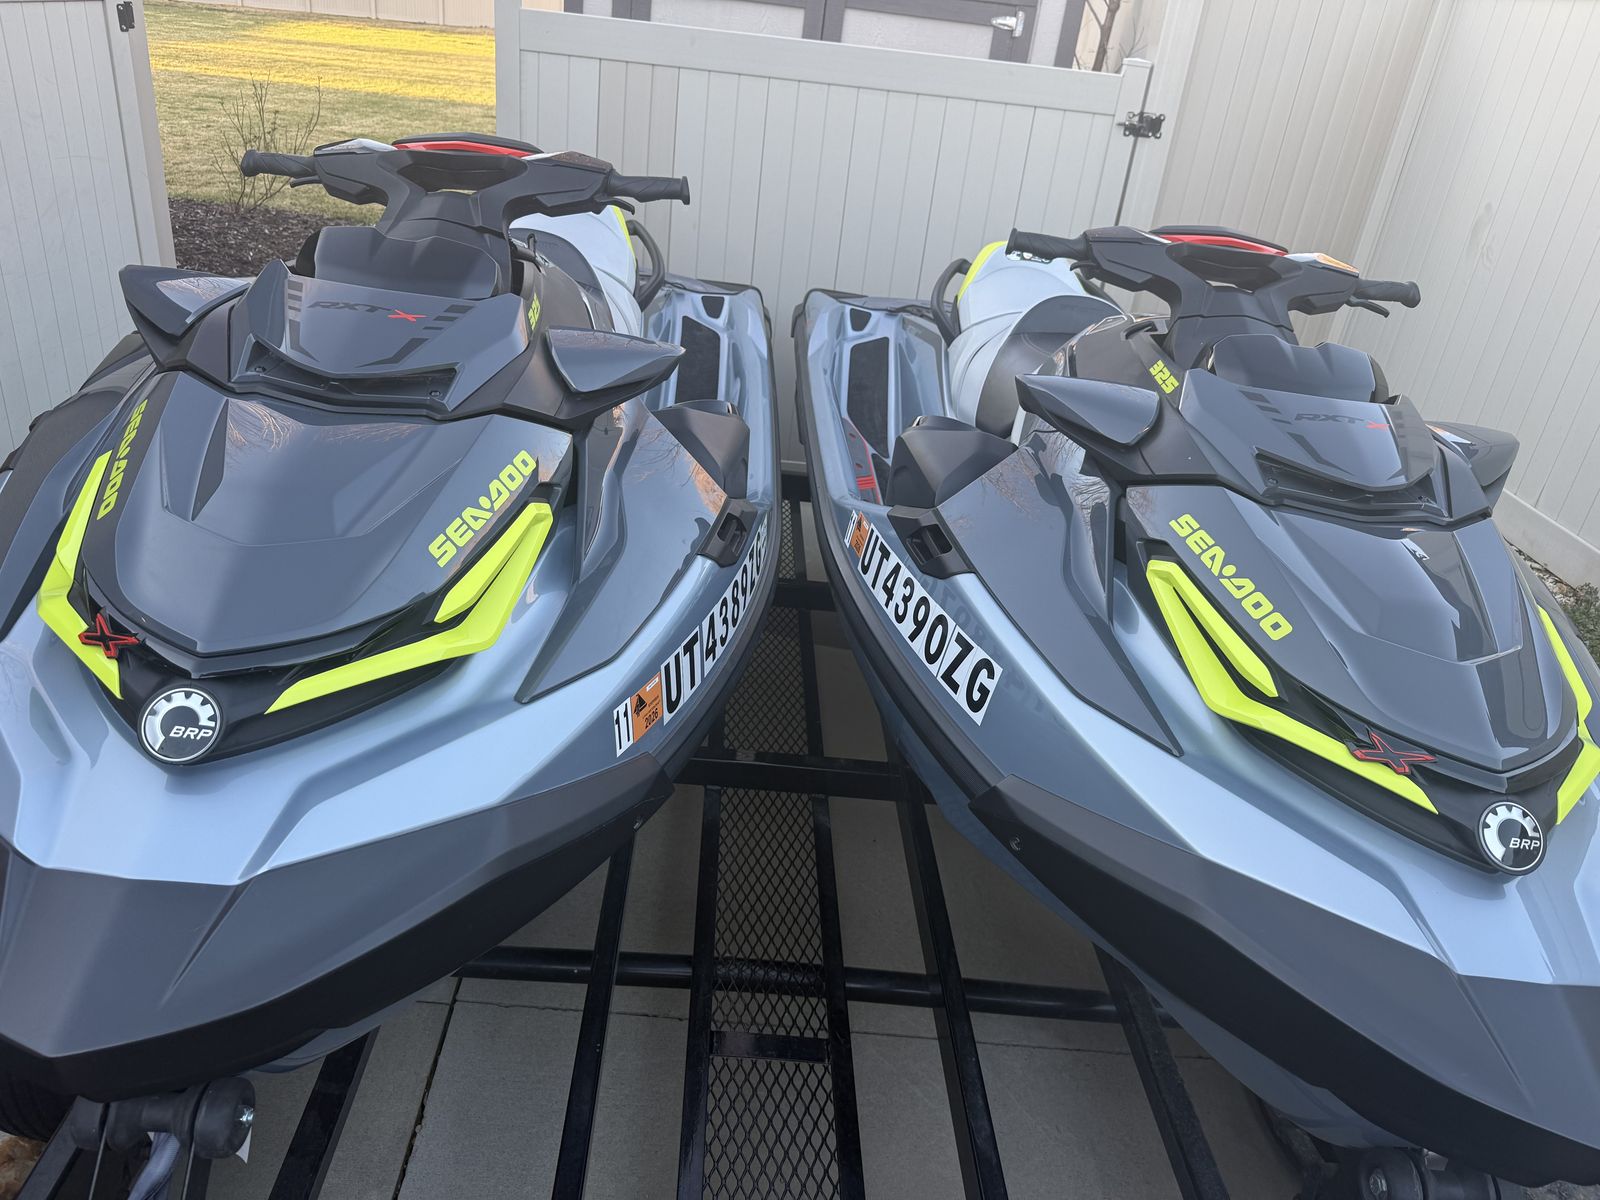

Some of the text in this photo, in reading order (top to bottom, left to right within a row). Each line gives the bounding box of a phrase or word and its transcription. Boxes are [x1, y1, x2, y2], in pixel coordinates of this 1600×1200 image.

[1149, 360, 1180, 394] 325
[614, 703, 630, 750] 11
[644, 708, 659, 730] 2026
[169, 724, 215, 742] BRP
[1509, 837, 1541, 851] BRP
